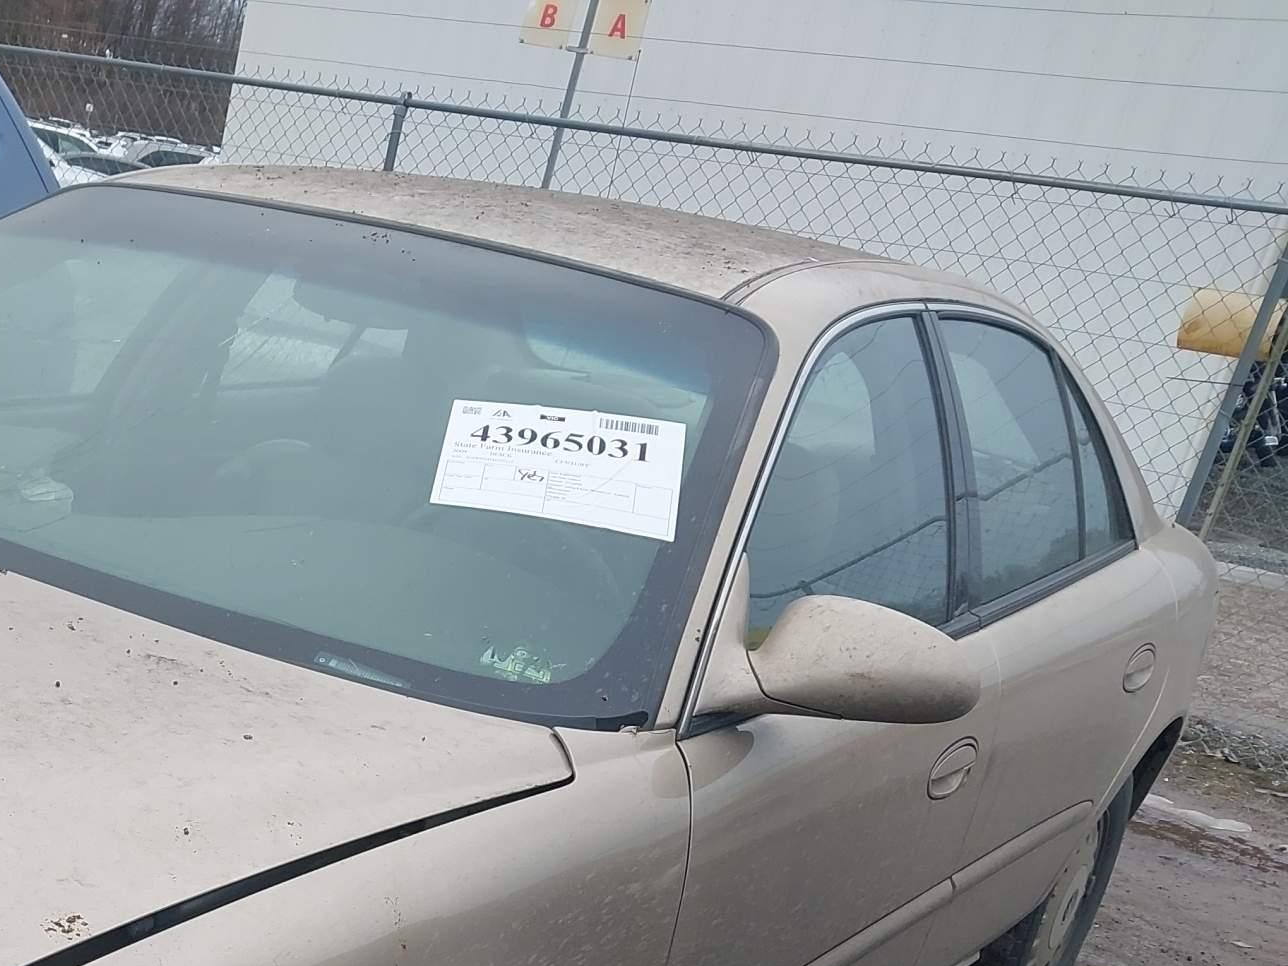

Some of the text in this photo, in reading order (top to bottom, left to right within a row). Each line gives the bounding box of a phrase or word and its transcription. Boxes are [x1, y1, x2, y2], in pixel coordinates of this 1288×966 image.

[539, 4, 559, 28] B
[607, 13, 627, 39] A
[454, 440, 553, 457] State Farm Insurance
[470, 424, 650, 462] 43965031
